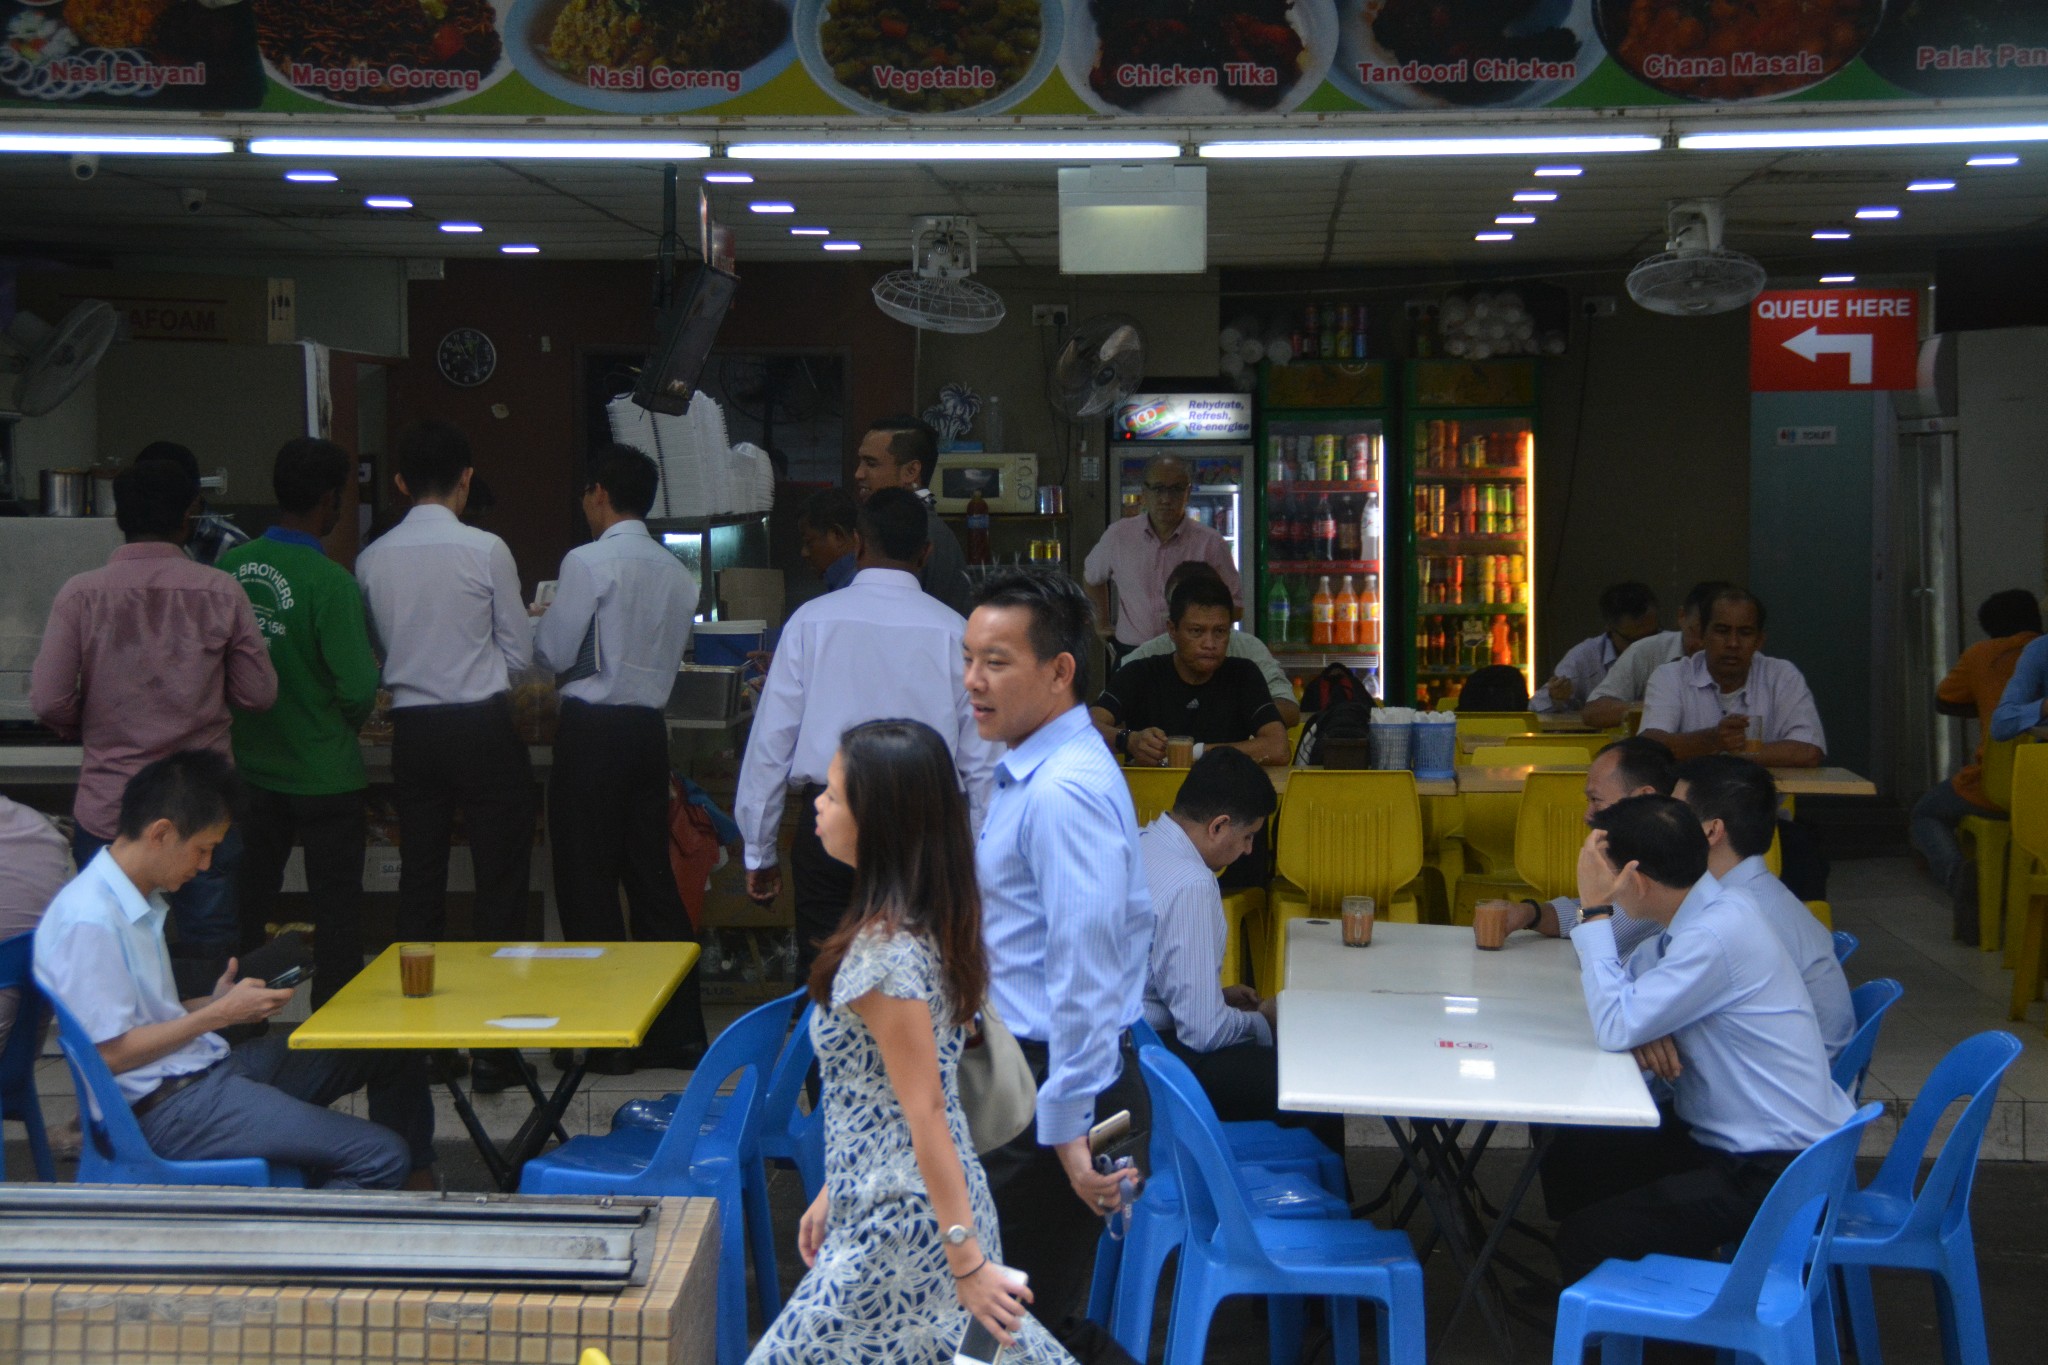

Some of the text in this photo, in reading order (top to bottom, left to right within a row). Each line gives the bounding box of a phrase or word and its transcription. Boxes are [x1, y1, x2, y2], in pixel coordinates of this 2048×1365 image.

[1357, 58, 1577, 82] Tandoori Chicken
[1644, 51, 1823, 78] Chana Masala
[1917, 45, 1992, 70] Palak
[51, 61, 206, 88] Nasi Briyani
[291, 63, 480, 91] Maggie Goreng
[589, 65, 741, 92] Nasi Goreng
[873, 65, 995, 92] Vegetable
[1118, 63, 1277, 86] Chicken Tika
[1757, 298, 1911, 319] QUEUE HERE
[1189, 400, 1245, 410] Rehydrate,
[1189, 411, 1232, 420] Refresh,
[1189, 422, 1250, 432] Re-energise
[238, 562, 295, 610] BROTHERS
